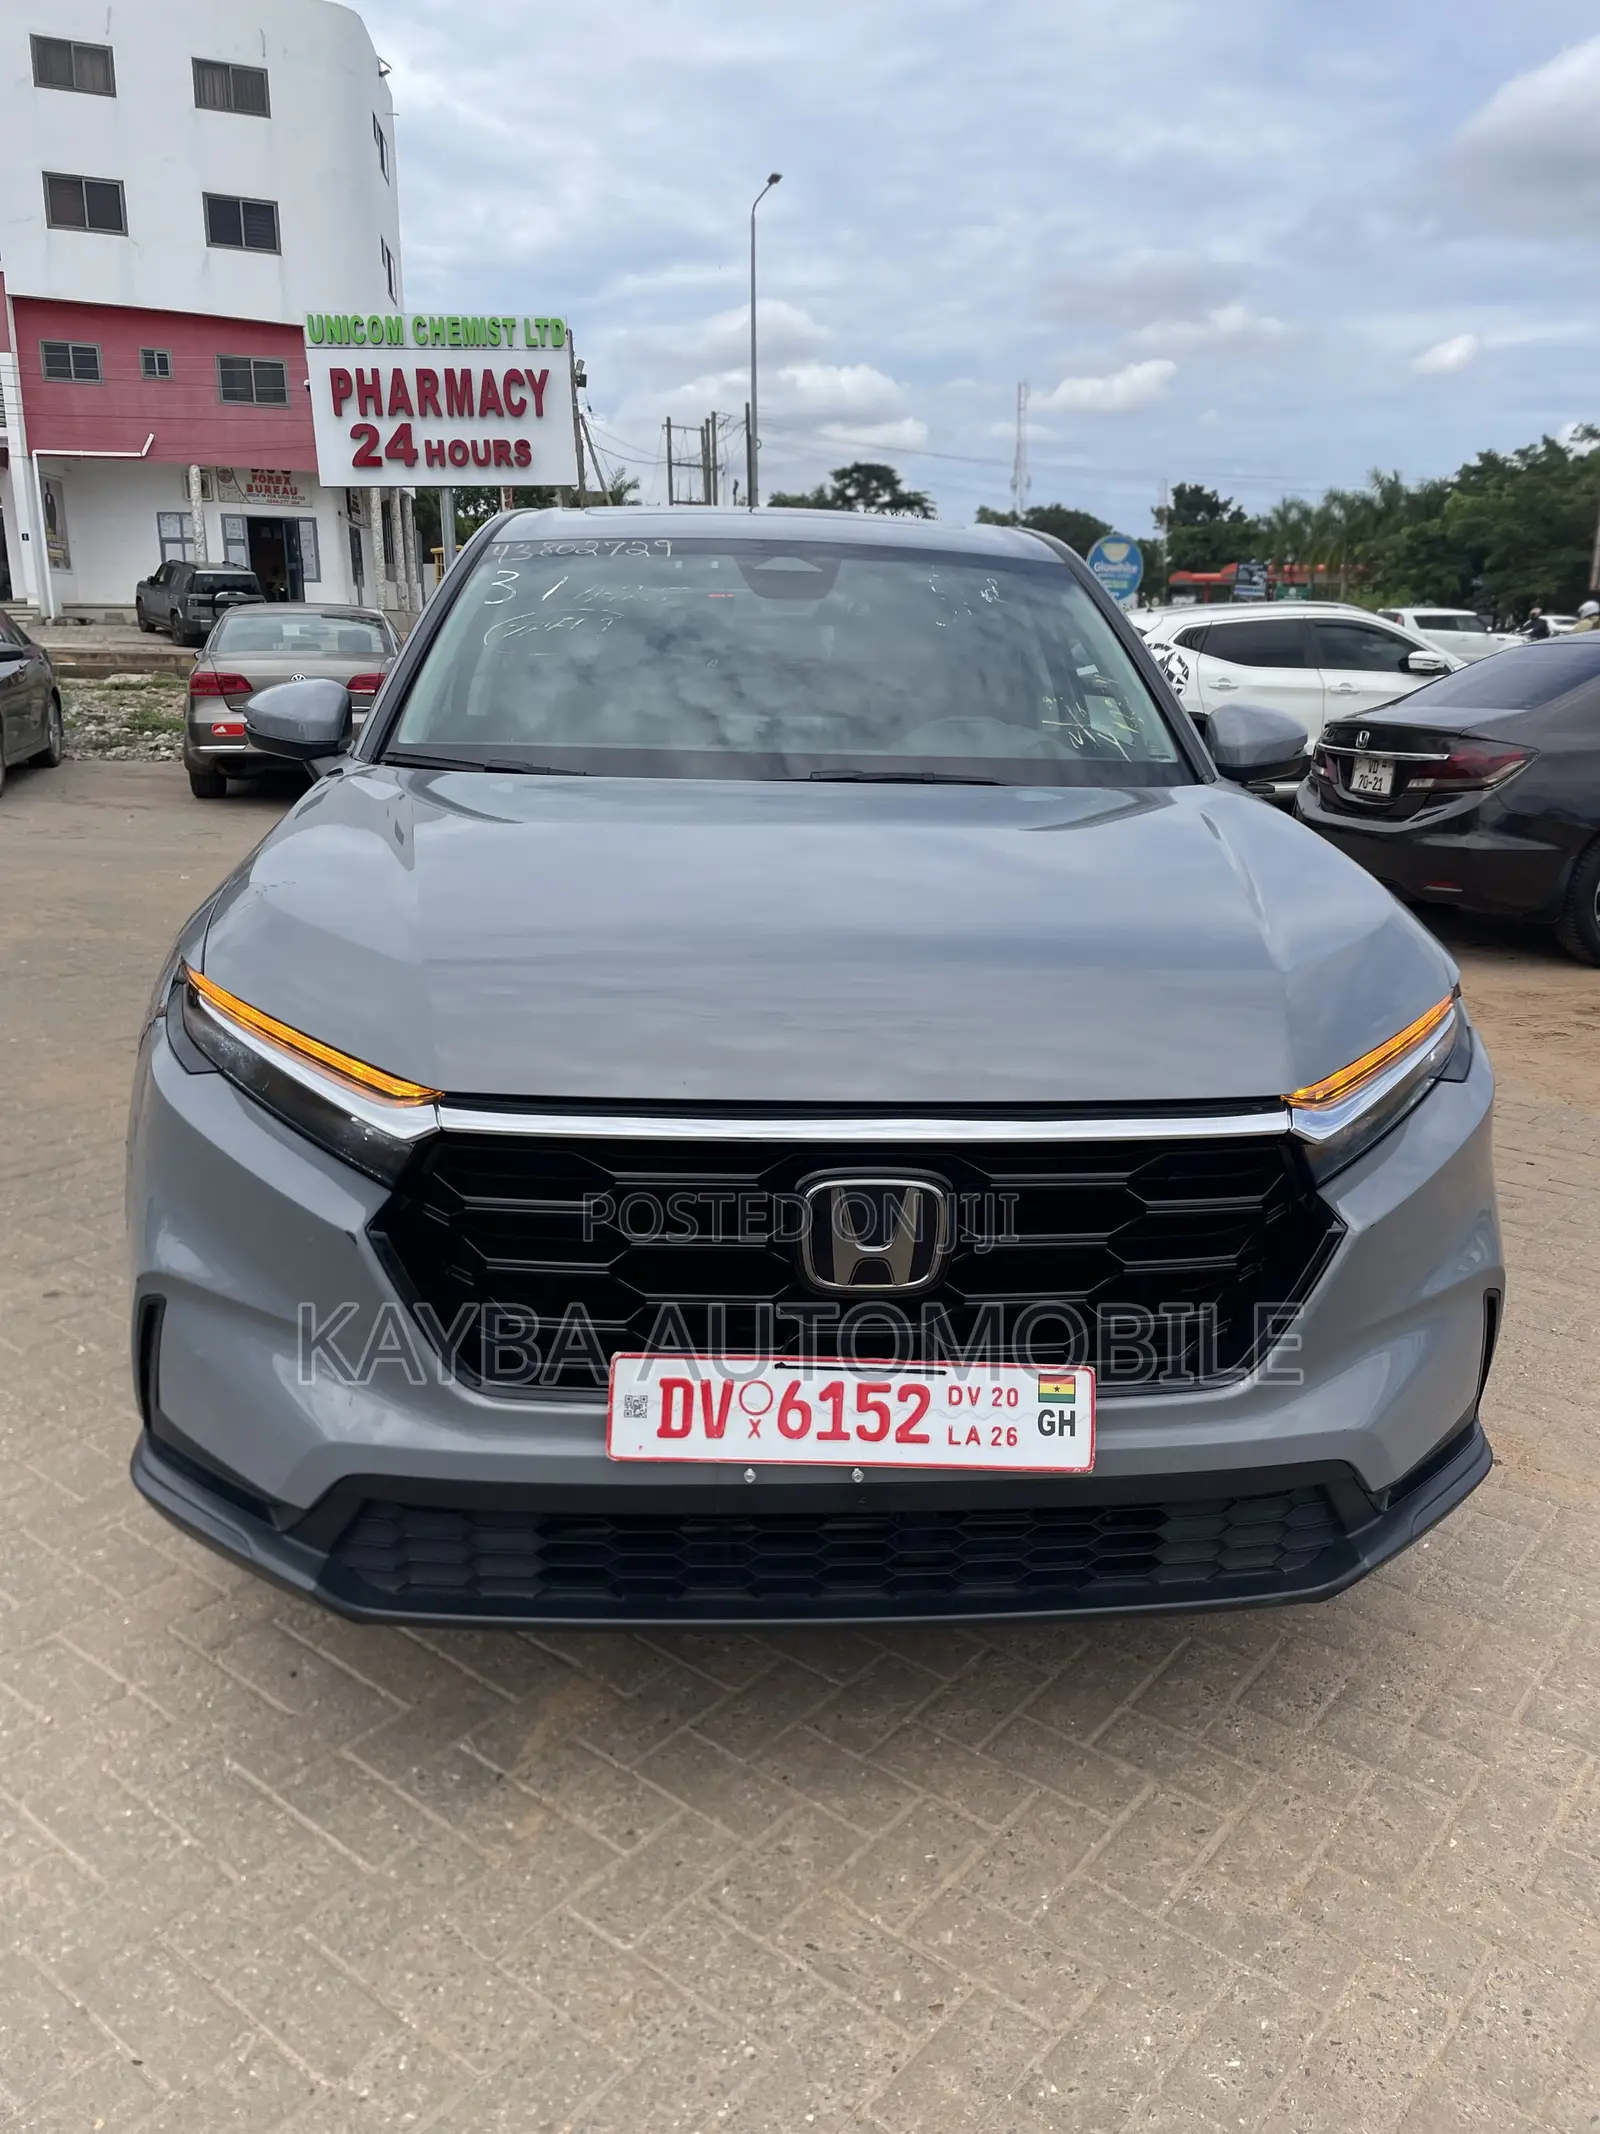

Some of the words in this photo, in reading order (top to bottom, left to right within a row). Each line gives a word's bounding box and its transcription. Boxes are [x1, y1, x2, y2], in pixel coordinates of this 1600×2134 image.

[307, 314, 405, 345] UNICOM
[412, 315, 516, 347] CHEMIST
[524, 317, 566, 348] LTD
[329, 367, 550, 418] PHARMACY
[350, 422, 418, 468] 24
[424, 438, 532, 468] HOURS
[246, 483, 298, 496] BUREAU
[251, 474, 292, 486] FOREX
[1358, 774, 1383, 791] 70-21
[948, 1384, 981, 1407] DV
[992, 1386, 1019, 1408] 20
[657, 1377, 735, 1439] DV
[777, 1379, 931, 1444] 6152
[1037, 1408, 1076, 1438] GH
[948, 1424, 981, 1446] LA
[990, 1425, 1018, 1447] 26
